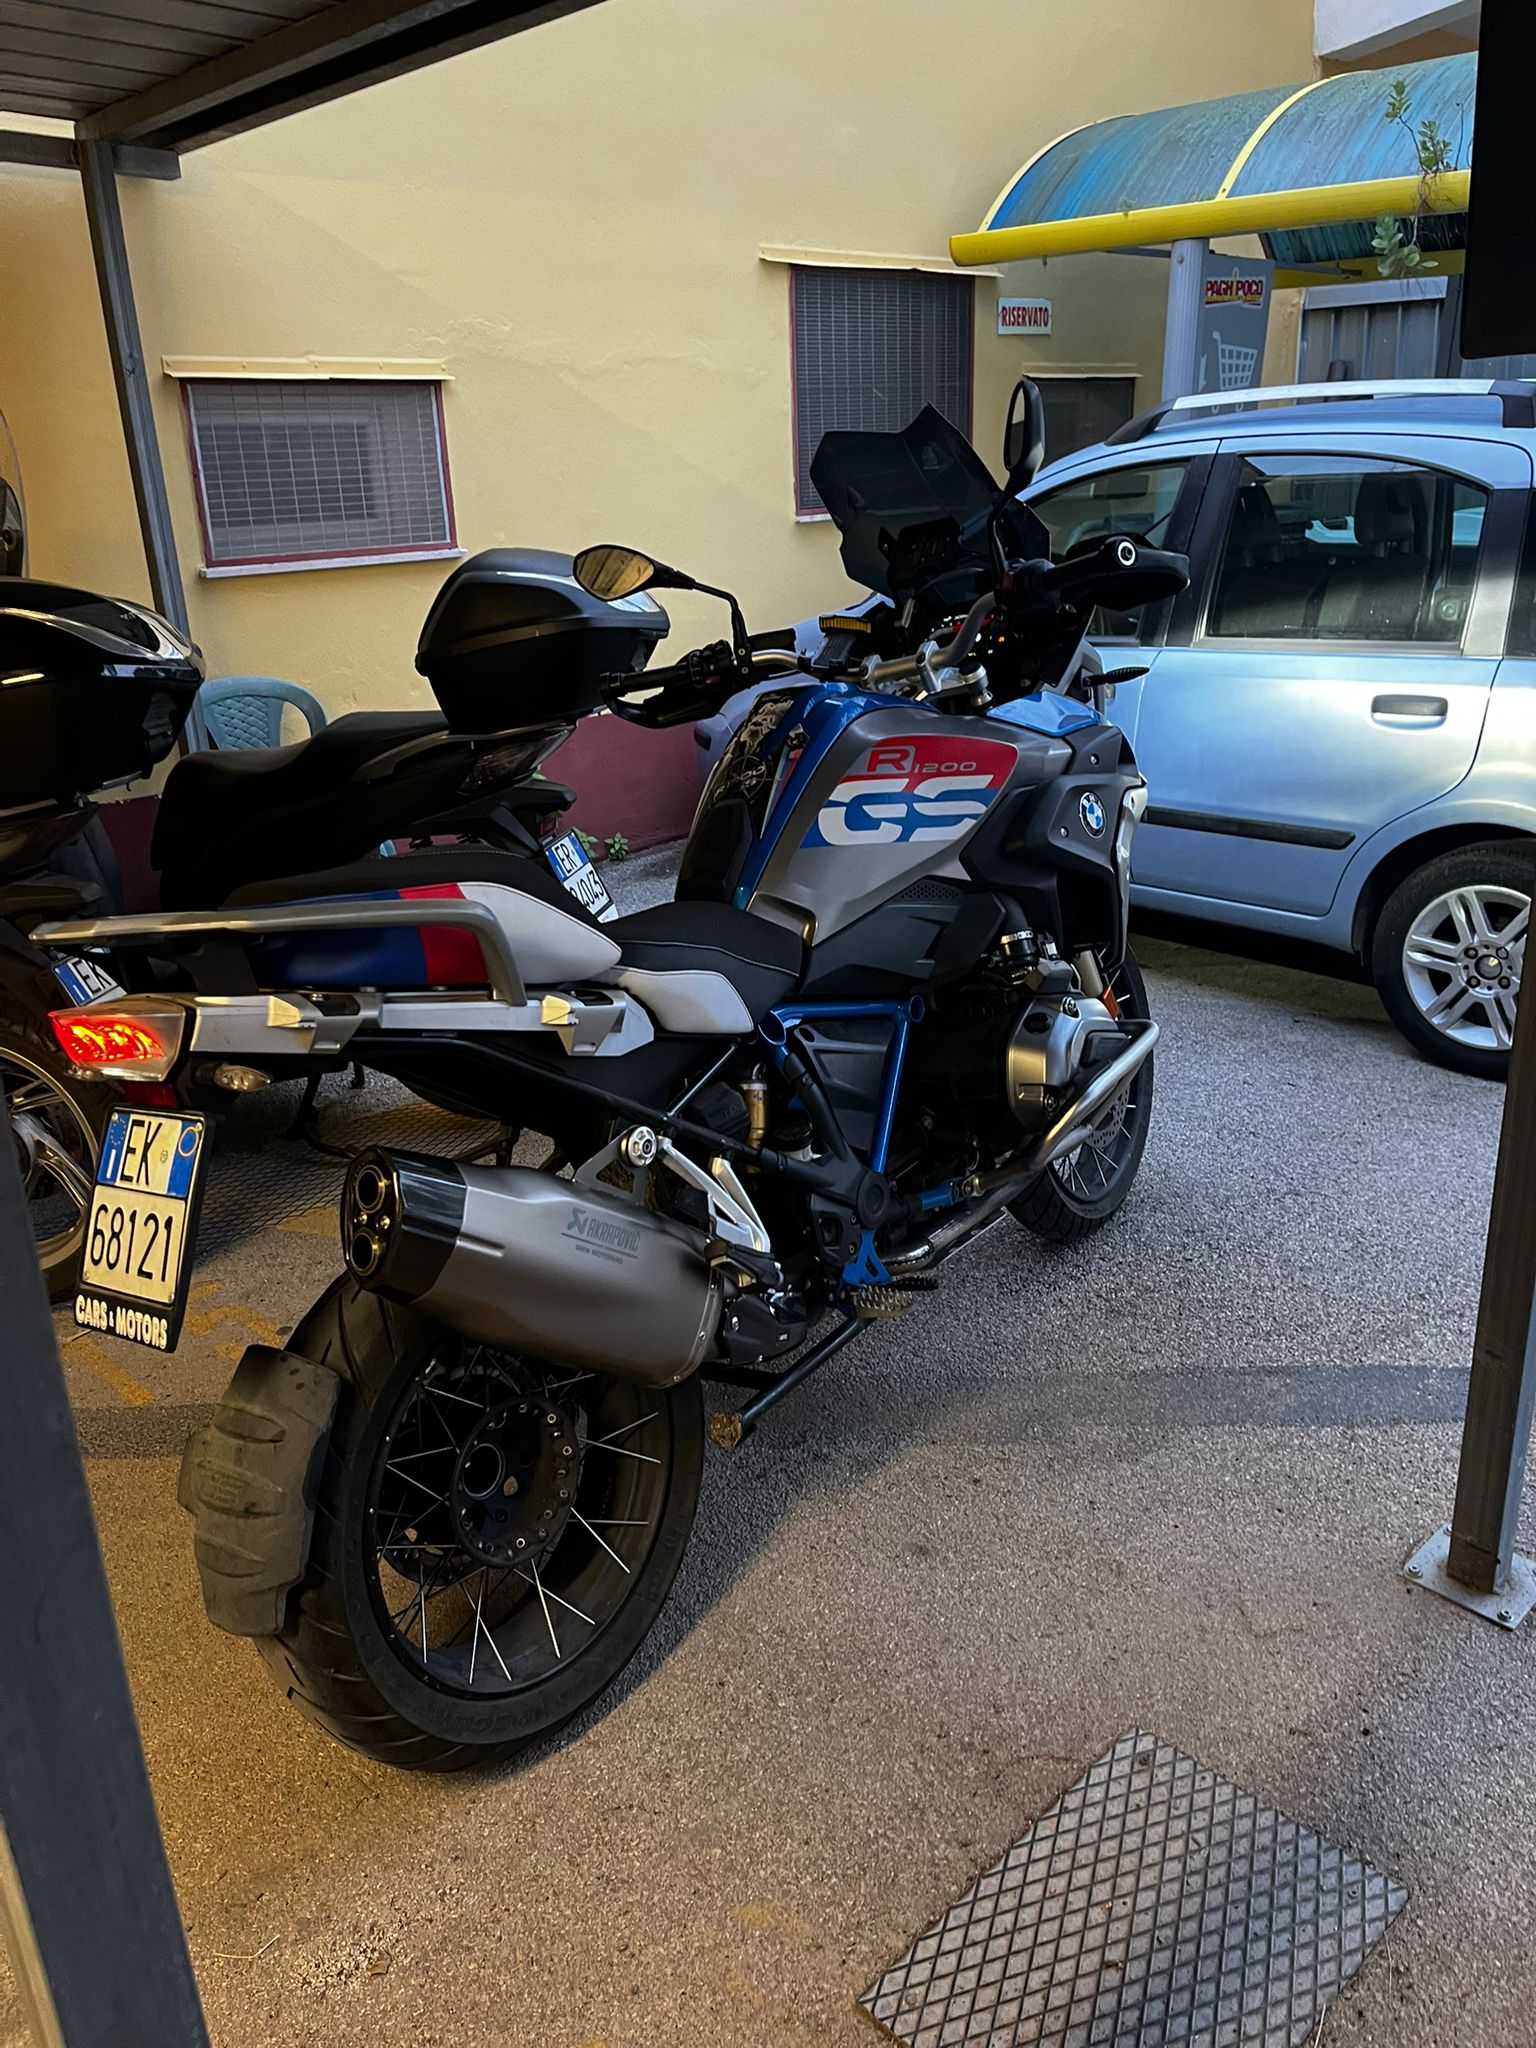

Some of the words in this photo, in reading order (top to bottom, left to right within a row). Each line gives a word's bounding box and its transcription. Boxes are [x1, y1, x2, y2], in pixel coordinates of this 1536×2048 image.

[1236, 279, 1263, 297] POCO
[1001, 305, 1050, 328] RISERVATO
[867, 748, 911, 773] R
[915, 761, 977, 774] 1200
[817, 774, 995, 846] GS
[554, 843, 578, 875] ER
[119, 1118, 163, 1186] EK
[90, 1203, 174, 1283] 68121
[75, 1294, 108, 1330] CARS
[116, 1306, 169, 1350] MOTORS
